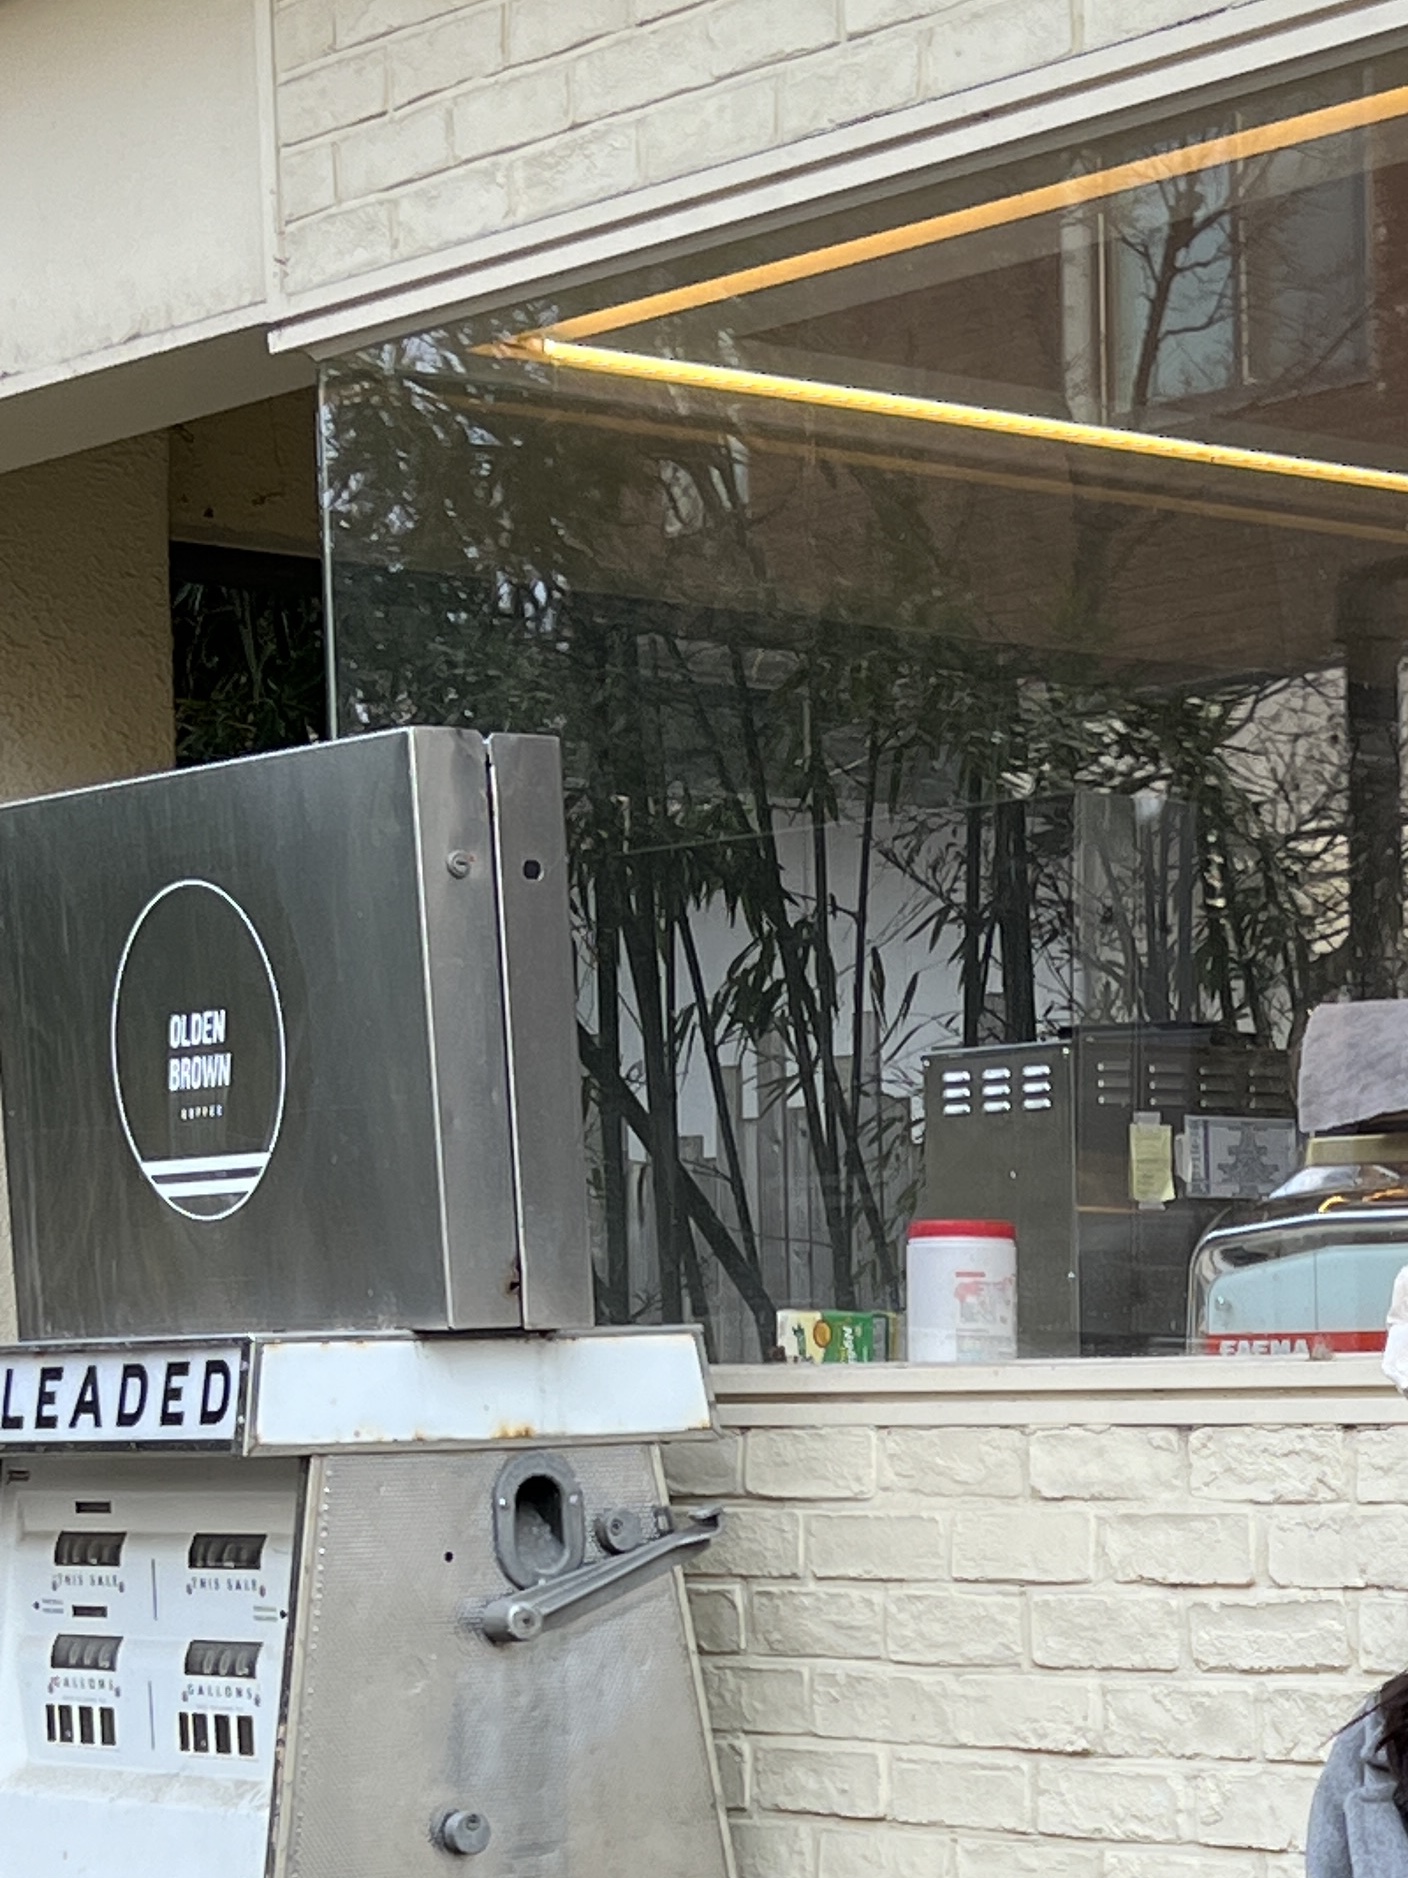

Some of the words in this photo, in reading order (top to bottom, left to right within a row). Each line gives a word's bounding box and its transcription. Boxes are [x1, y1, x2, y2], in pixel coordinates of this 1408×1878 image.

[169, 1009, 226, 1049] OLDEN
[168, 1052, 232, 1092] BROWN
[1, 1359, 232, 1430] LEADED
[191, 1576, 221, 1591] THIS
[187, 1683, 253, 1700] GALLONS
